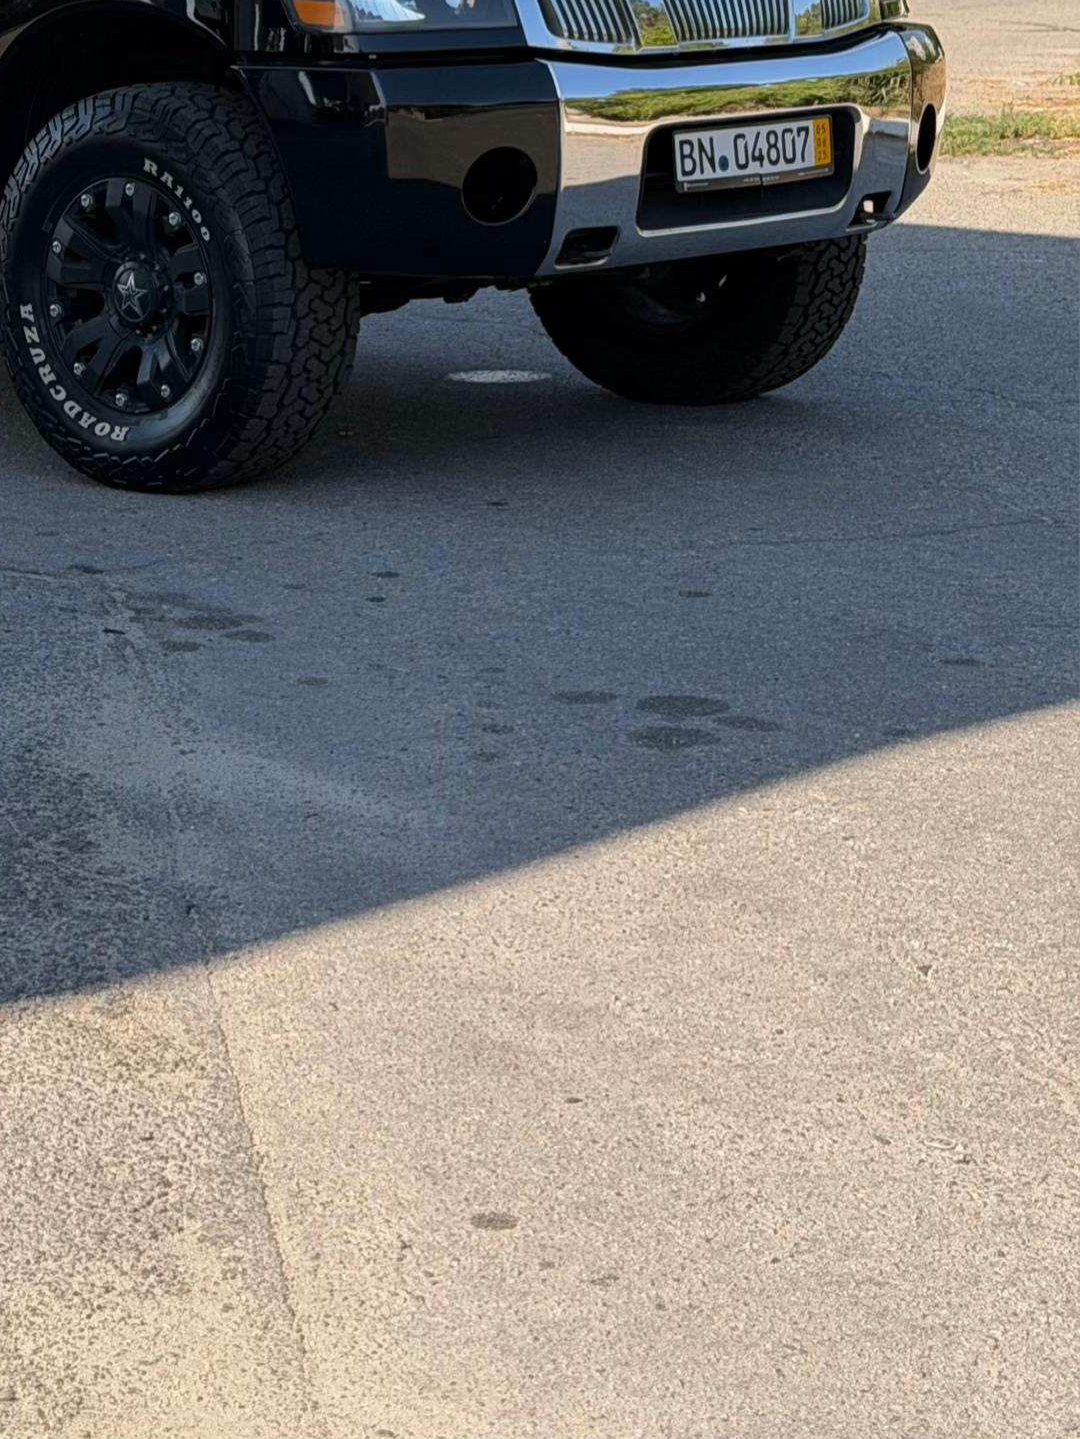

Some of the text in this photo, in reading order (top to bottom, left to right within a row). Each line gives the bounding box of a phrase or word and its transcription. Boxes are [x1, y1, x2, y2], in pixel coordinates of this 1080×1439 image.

[678, 125, 810, 177] BN 04807
[142, 157, 211, 242] RA1100
[19, 302, 132, 443] ROADCRUZA
